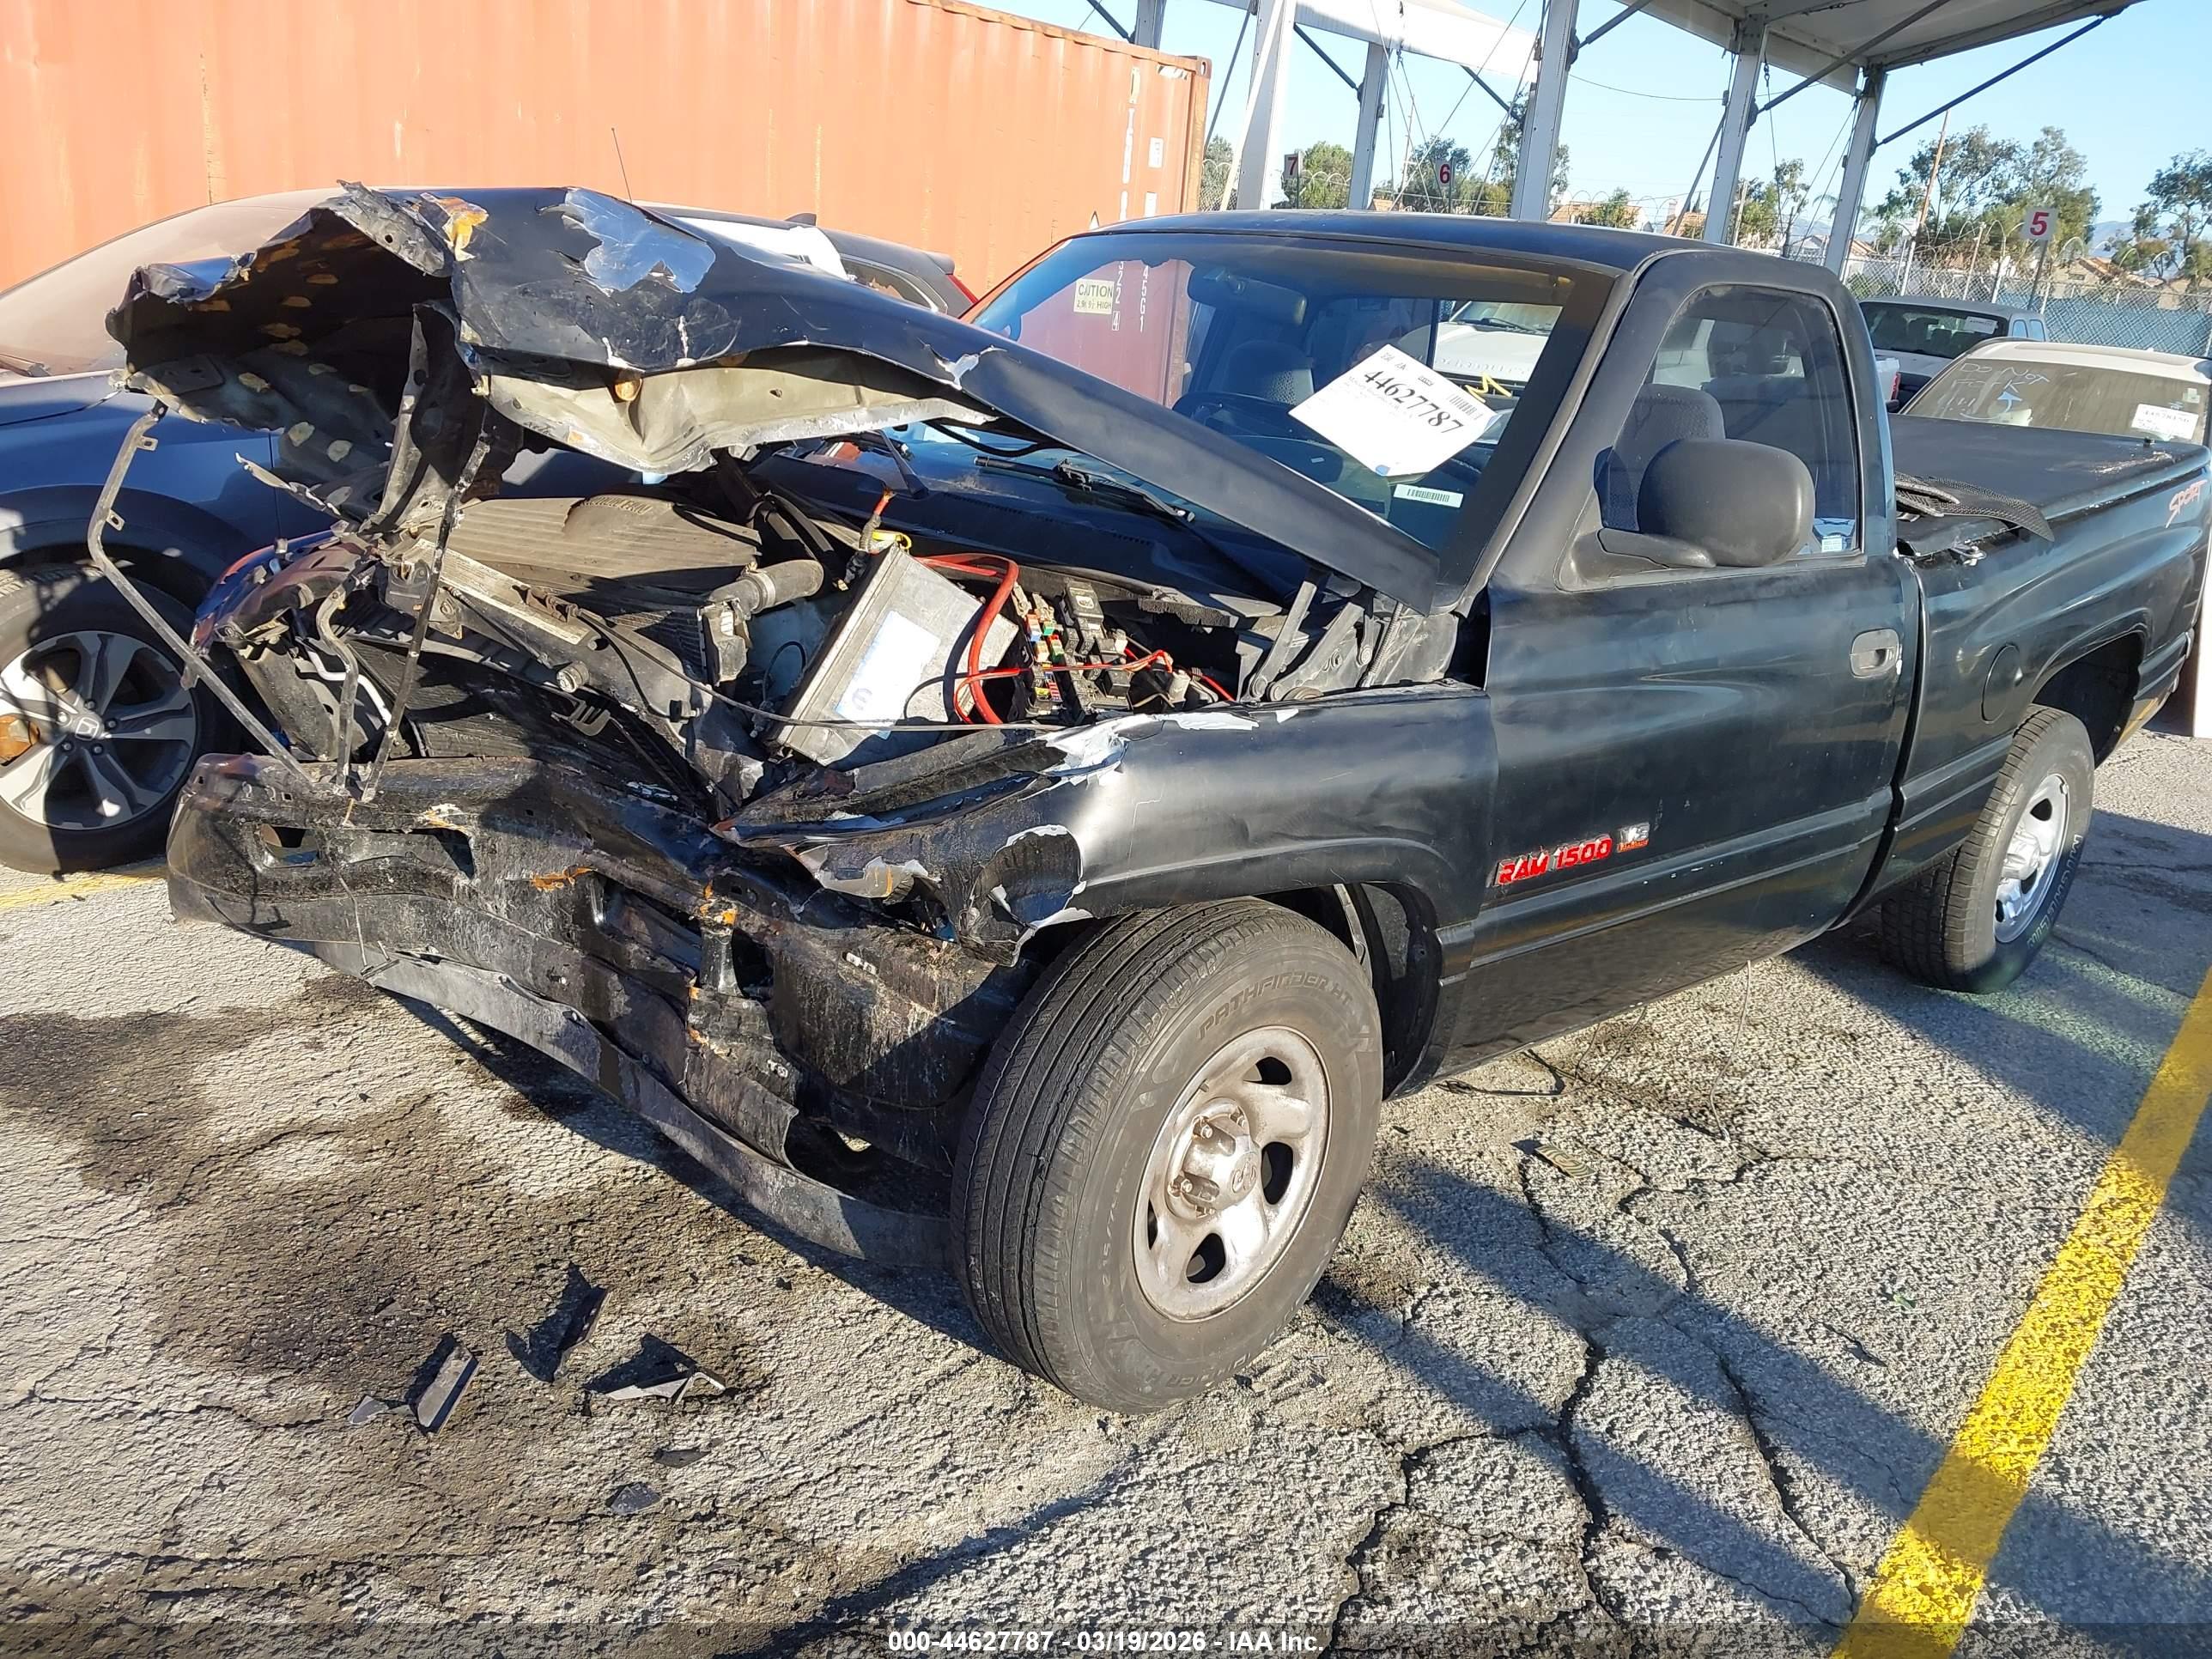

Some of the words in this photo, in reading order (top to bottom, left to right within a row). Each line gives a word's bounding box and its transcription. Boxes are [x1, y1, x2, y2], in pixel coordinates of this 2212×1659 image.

[1287, 156, 1297, 176] 7
[1439, 163, 1451, 184] 6
[2030, 211, 2051, 236] 5
[1364, 370, 1464, 434] 4462787
[1498, 852, 1550, 885] RAM
[1553, 835, 1613, 869] 1500
[1197, 970, 1329, 1039] PATHFINDER
